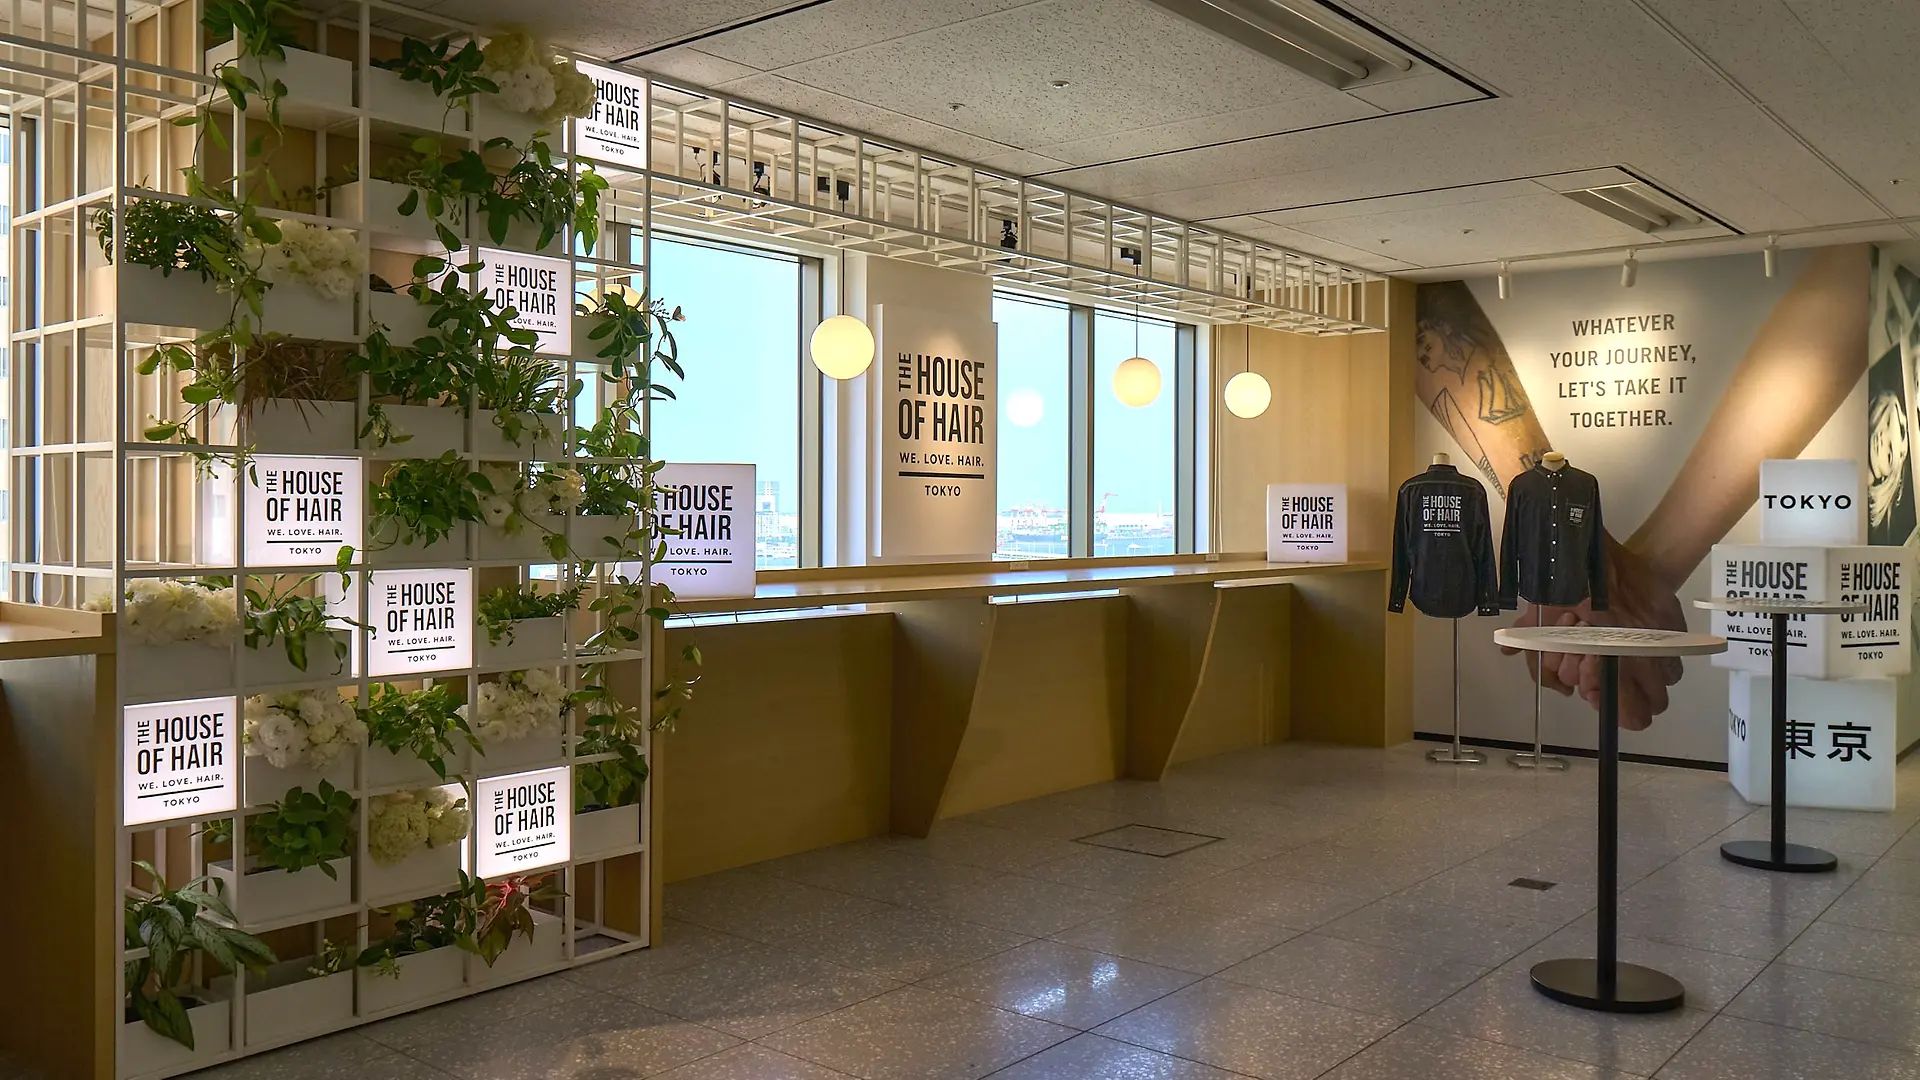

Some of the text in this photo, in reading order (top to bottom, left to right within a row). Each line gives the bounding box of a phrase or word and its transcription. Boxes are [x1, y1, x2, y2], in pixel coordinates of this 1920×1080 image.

[596, 79, 639, 108] HOUSE
[606, 104, 639, 131] HAIR
[600, 129, 619, 138] LOVE.
[621, 133, 640, 143] HAIR.
[601, 145, 624, 155] TOKYO
[495, 263, 504, 284] THE
[508, 265, 557, 291] HOUSE
[495, 287, 556, 315] OF HAIR
[536, 320, 556, 328] HAIR.
[1572, 314, 1675, 337] WHATEVER
[1550, 344, 1696, 369] YOUR JOURNEY,
[898, 352, 911, 392] THE
[917, 354, 985, 401] HOUSE
[1558, 376, 1687, 399] LET'S TAKE IT
[898, 398, 984, 445] OF HAIR
[1570, 409, 1672, 428] TOGETHER.
[900, 452, 984, 467] WE. LOVE. HAIR.
[266, 470, 277, 494] THE
[282, 470, 343, 495] HOUSE
[925, 485, 961, 497] TOKYO
[664, 484, 733, 511] HOUSE
[1282, 497, 1290, 512] THE
[1292, 496, 1334, 512] HOUSE
[1430, 495, 1462, 509] HOUSE
[1764, 494, 1852, 509] TOKYO
[266, 497, 342, 522] OF HAIR
[1423, 508, 1460, 522] OF HAIR
[679, 514, 731, 540] HAIR
[1282, 513, 1333, 530] OF HAIR
[670, 548, 732, 556] LOVE. HAIR.
[671, 568, 708, 576] TOKYO
[1726, 560, 1738, 586] THE
[1741, 560, 1808, 591] HOUSE
[1841, 563, 1850, 590] THE
[1853, 562, 1900, 591] HOUSE
[387, 584, 397, 607] THE
[401, 582, 456, 606] HOUSE
[1863, 593, 1899, 622] HAIR
[387, 607, 454, 633] OF HAIR
[1727, 624, 1744, 633] WE.
[1786, 629, 1807, 638] AIR.
[406, 637, 431, 645] LOVE.
[1841, 629, 1900, 639] WE. LOVE. HAIR.
[407, 654, 437, 662] TOKYO
[1748, 647, 1773, 656] TOK
[1858, 651, 1883, 660] TOKYO
[137, 720, 150, 746] THE
[155, 713, 224, 744] HOUSE
[137, 742, 223, 775] OF HAIR
[138, 774, 224, 790] WE. LOVE. HAIR.
[163, 796, 200, 807] TOKYO
[494, 790, 504, 812] THE
[507, 781, 556, 810] HOUSE
[495, 805, 555, 836] OF HAIR
[495, 832, 556, 848] WE. LOVE. HAIR.
[513, 851, 539, 861] TOKYO
